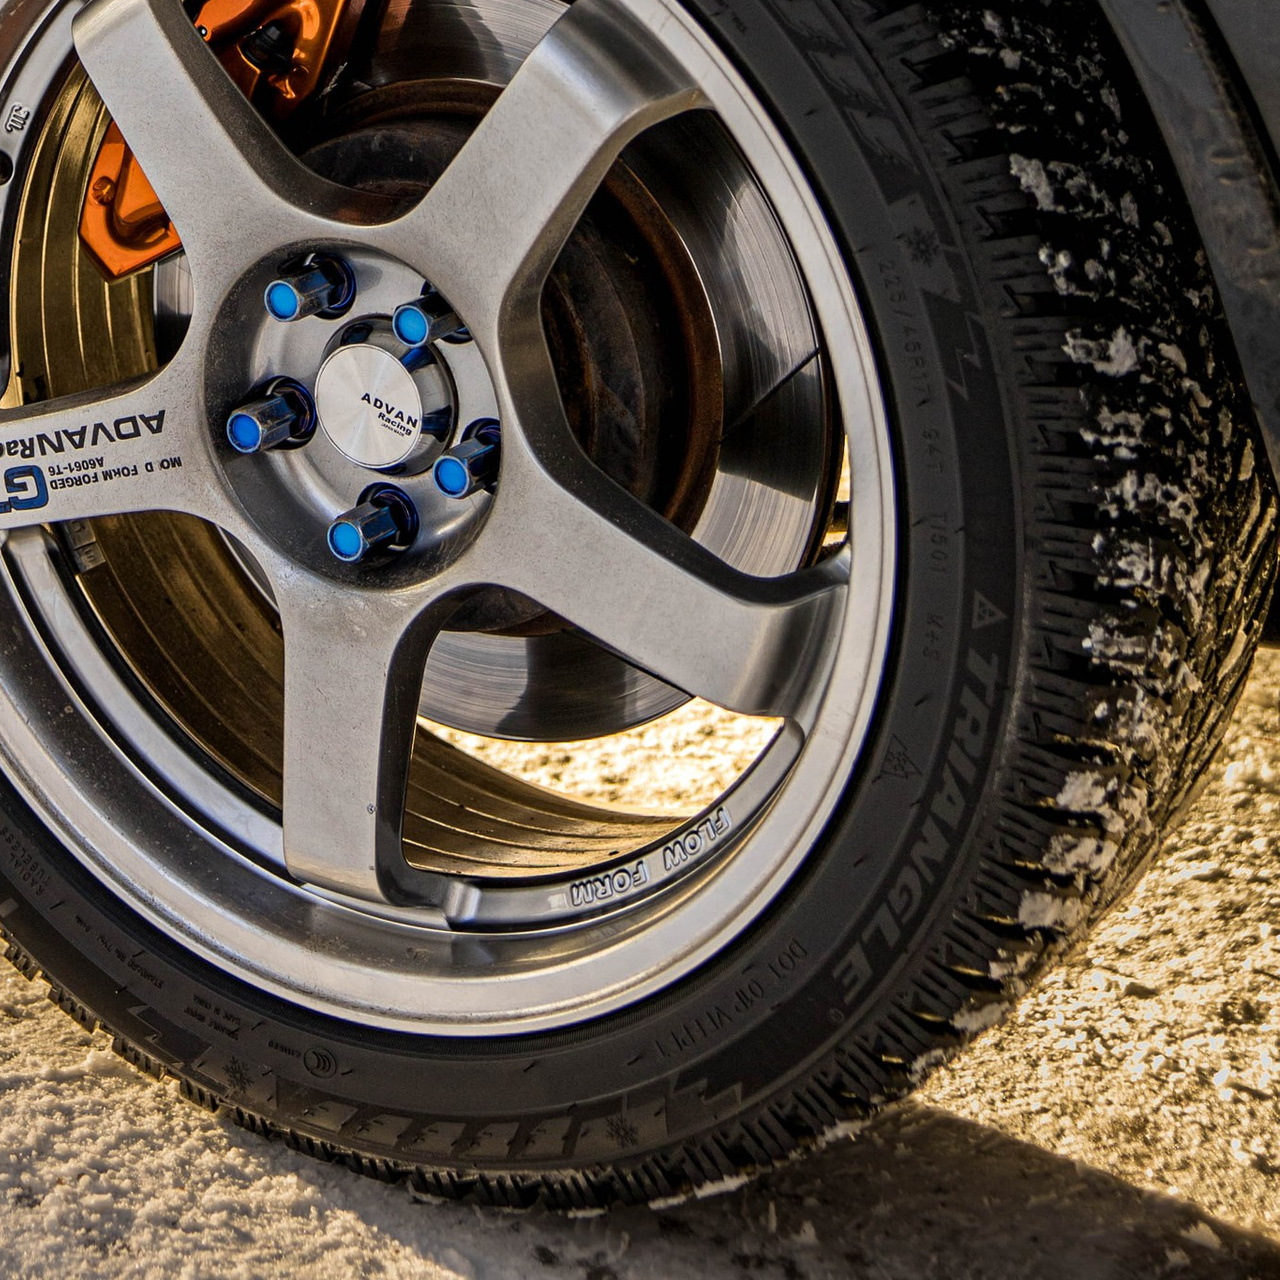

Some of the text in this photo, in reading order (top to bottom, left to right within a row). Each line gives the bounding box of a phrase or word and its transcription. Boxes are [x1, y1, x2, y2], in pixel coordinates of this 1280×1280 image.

[360, 391, 419, 428] ADVAN
[377, 411, 413, 437] Racing
[48, 455, 105, 477] A6061-T6
[146, 455, 182, 472] MOD
[50, 470, 99, 491] FORGED
[833, 648, 1000, 1006] TRIANGLE
[571, 807, 732, 907] FLOW FORM
